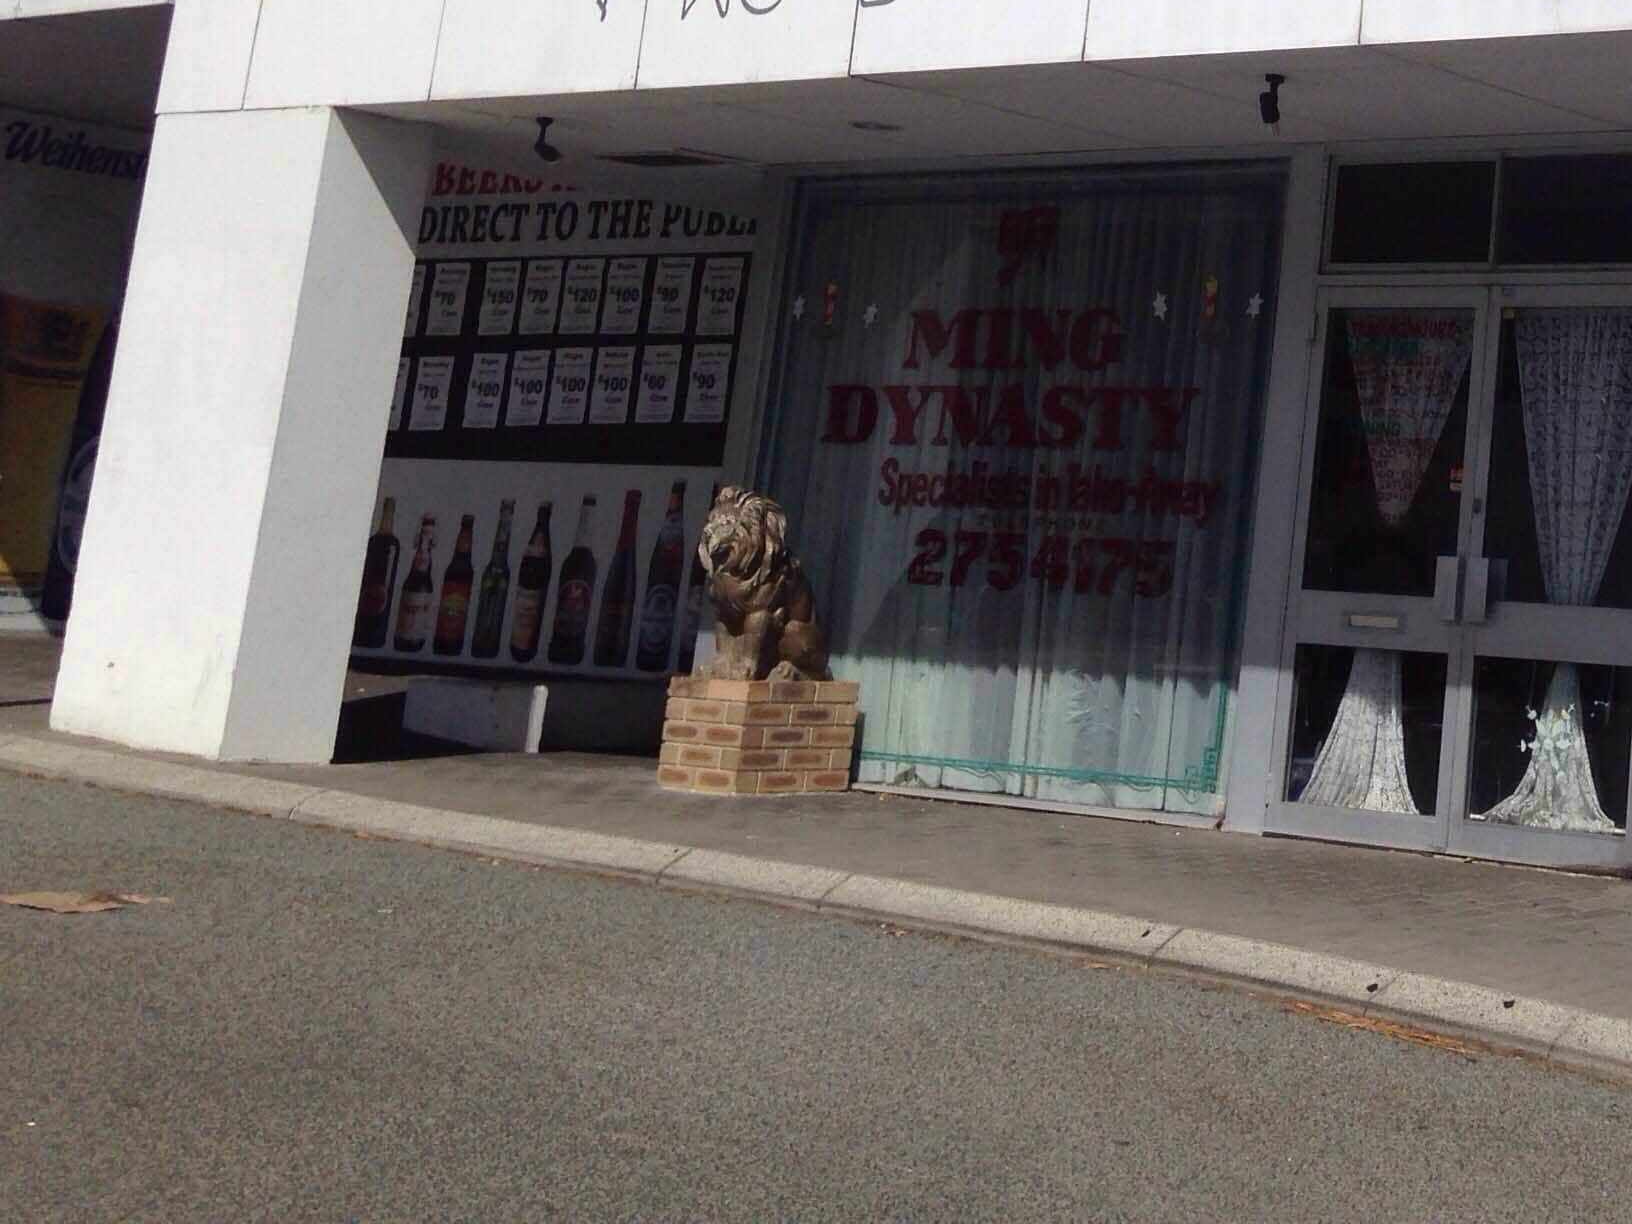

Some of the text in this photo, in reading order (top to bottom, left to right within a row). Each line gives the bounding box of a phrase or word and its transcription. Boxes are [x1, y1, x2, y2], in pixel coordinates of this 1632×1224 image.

[418, 203, 530, 245] DIRECT
[537, 200, 579, 241] TO
[587, 200, 654, 240] THE
[902, 308, 1124, 371] MING
[821, 383, 1200, 452] DYNASTY
